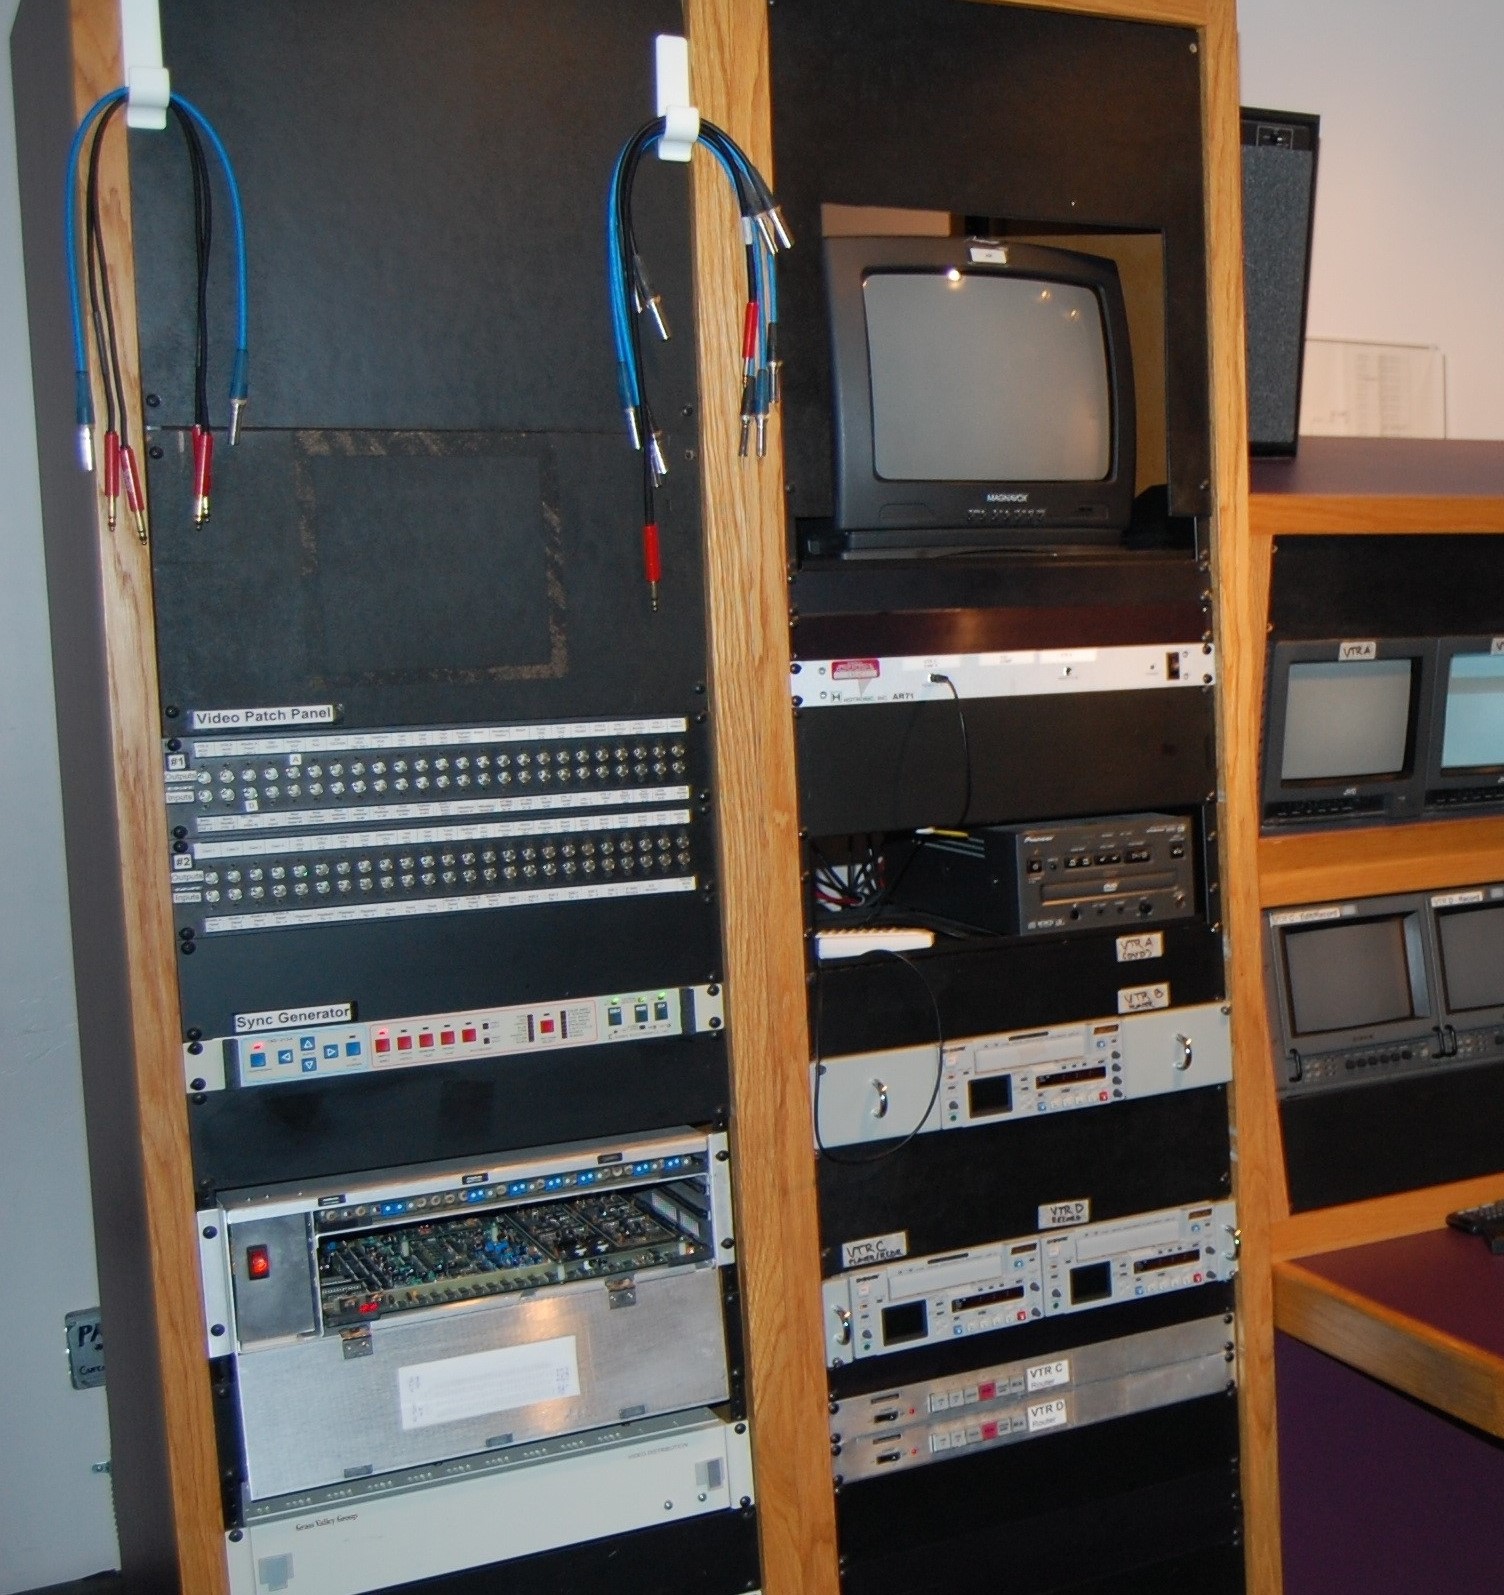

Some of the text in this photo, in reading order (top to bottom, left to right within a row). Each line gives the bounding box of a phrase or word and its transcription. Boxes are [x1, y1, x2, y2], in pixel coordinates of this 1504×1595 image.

[1343, 646, 1371, 658] VTR A
[892, 692, 914, 700] AR71
[197, 706, 331, 724] Video Patch Panel
[171, 757, 184, 767] #1
[167, 772, 197, 781] Outputs
[169, 793, 193, 802] Inputs
[176, 857, 190, 867] #2
[173, 873, 204, 882] Outputs
[175, 893, 200, 902] Inputs
[237, 1006, 350, 1030] Sync Generator
[1050, 1203, 1084, 1215] VTR D
[847, 1240, 886, 1258] VTR C
[1030, 1362, 1063, 1378] VTR C
[1031, 1401, 1064, 1417] VTR D
[1032, 1416, 1056, 1427] Router
[295, 1522, 315, 1531] Grass
[337, 1513, 358, 1522] Group
